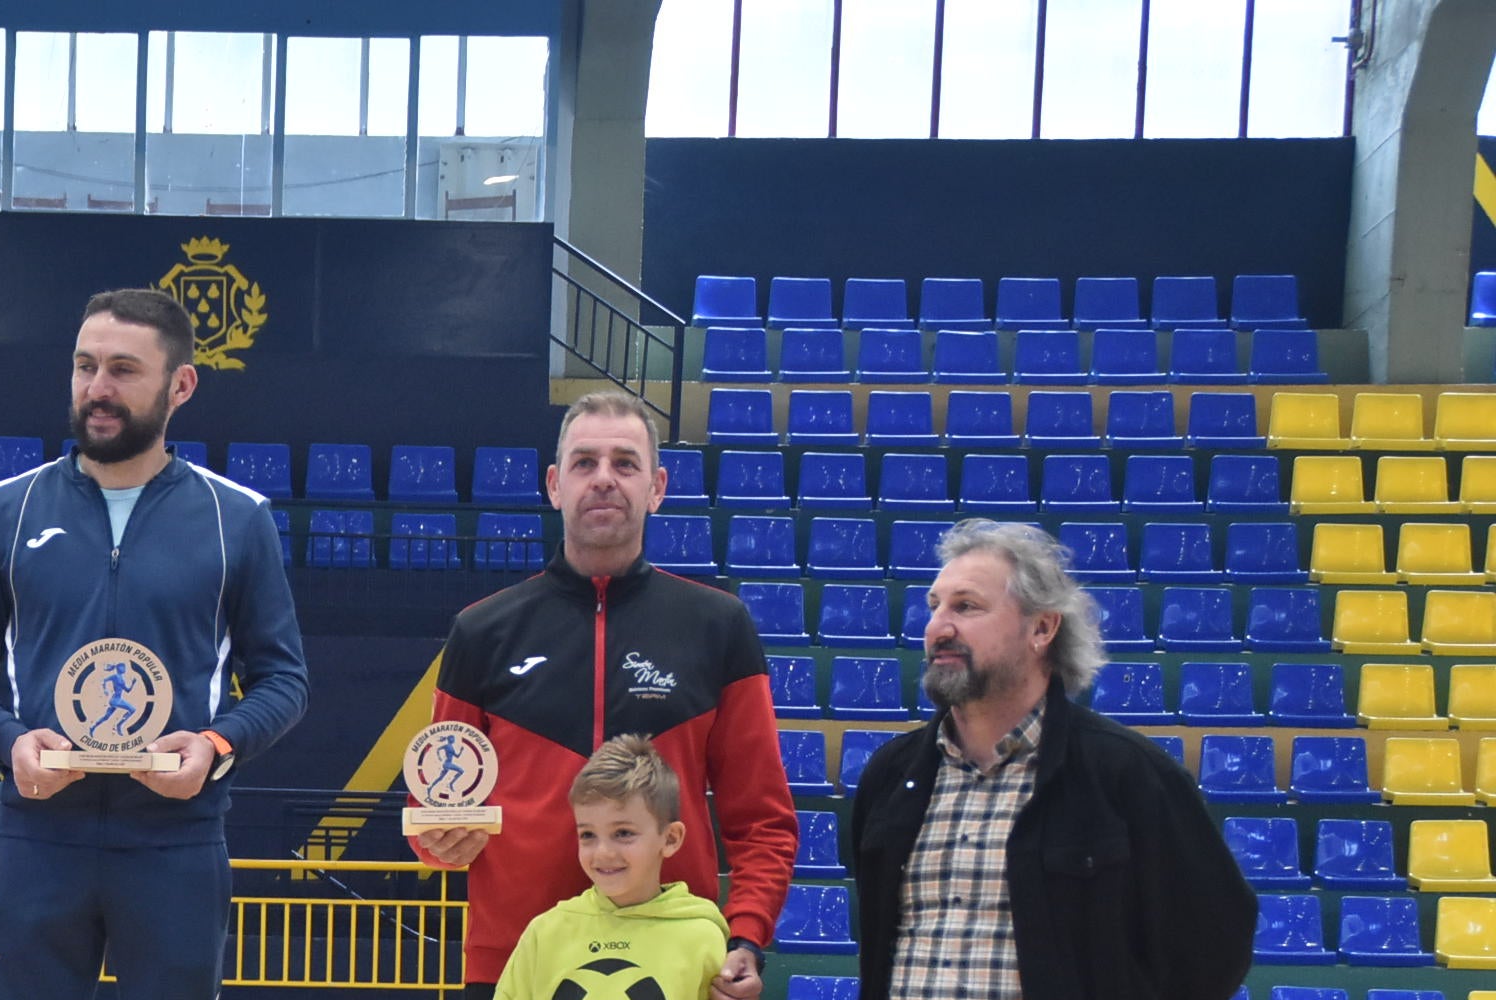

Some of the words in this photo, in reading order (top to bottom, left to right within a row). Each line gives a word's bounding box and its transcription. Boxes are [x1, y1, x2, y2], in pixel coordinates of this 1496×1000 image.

[68, 653, 89, 677] MEDIA
[90, 642, 132, 657] MARATÓN
[133, 650, 162, 681] POPULAR
[80, 735, 107, 751] CIUDAD
[109, 743, 120, 752] DE
[411, 731, 431, 753] MEDIA
[429, 723, 463, 736] MARATÓN
[463, 728, 491, 753] POPULAR
[603, 941, 631, 950] XBOX
